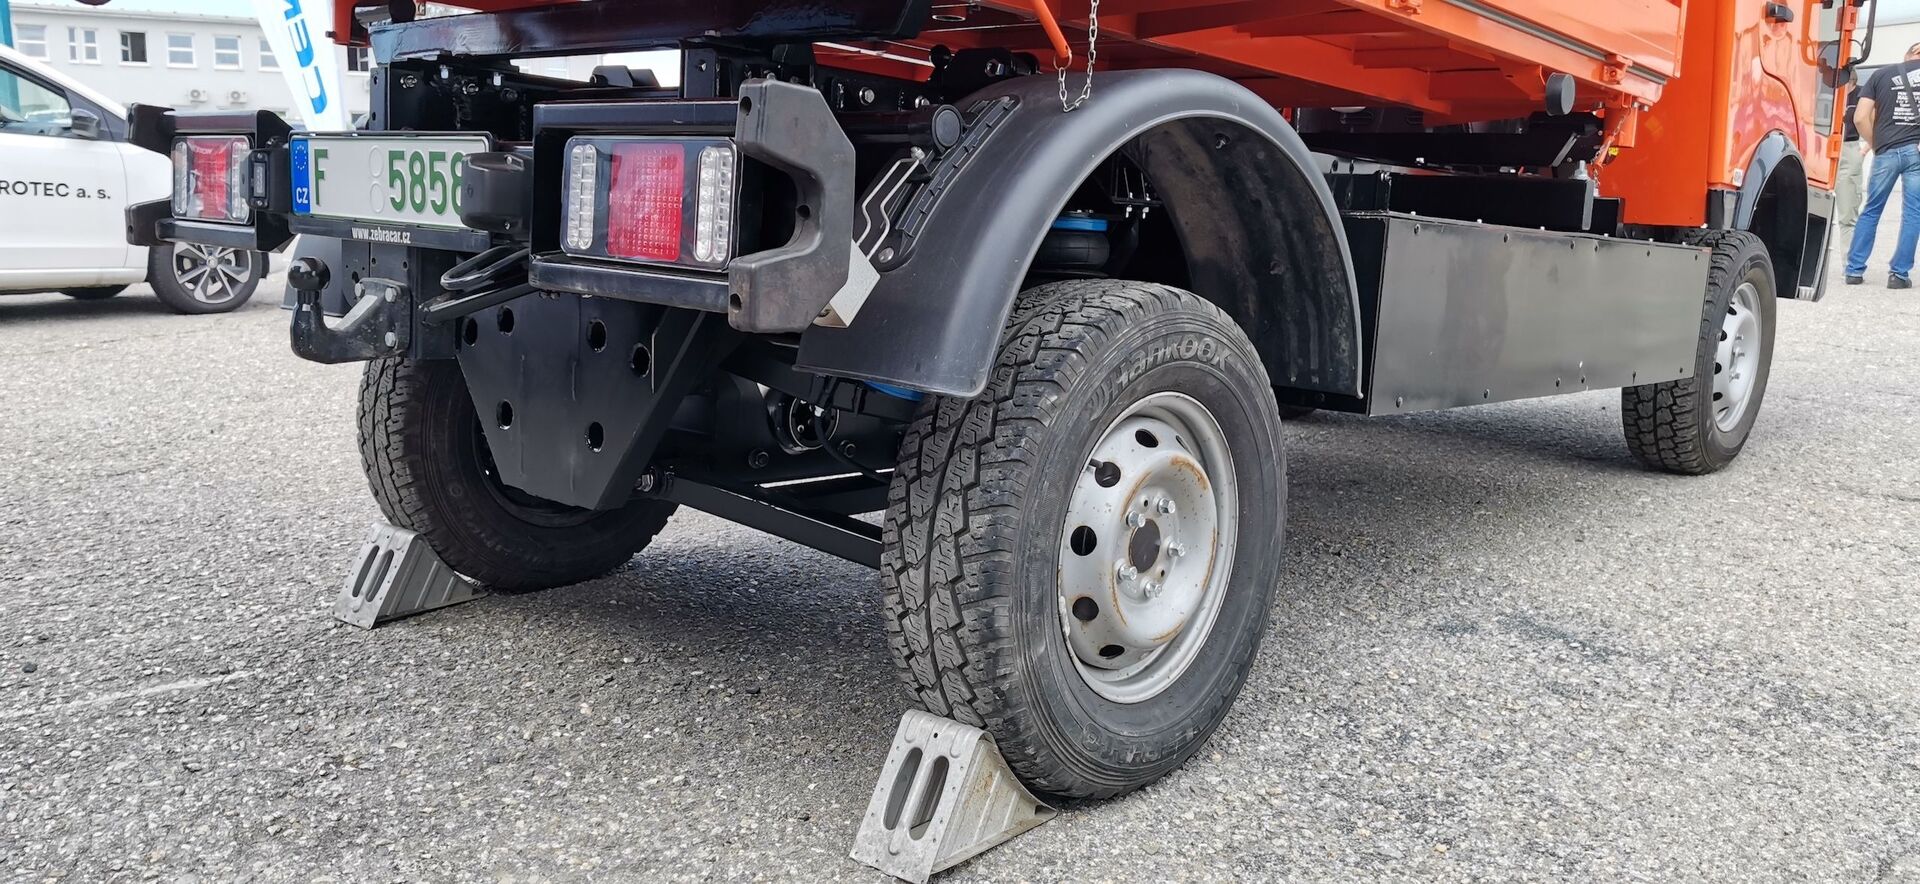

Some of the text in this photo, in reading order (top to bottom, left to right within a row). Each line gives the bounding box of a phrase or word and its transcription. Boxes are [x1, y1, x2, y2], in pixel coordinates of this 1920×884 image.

[314, 149, 329, 206] F
[0, 180, 111, 200] ROTEC a. s.
[296, 187, 309, 204] CZ
[351, 226, 412, 244] www.zebracar.cz
